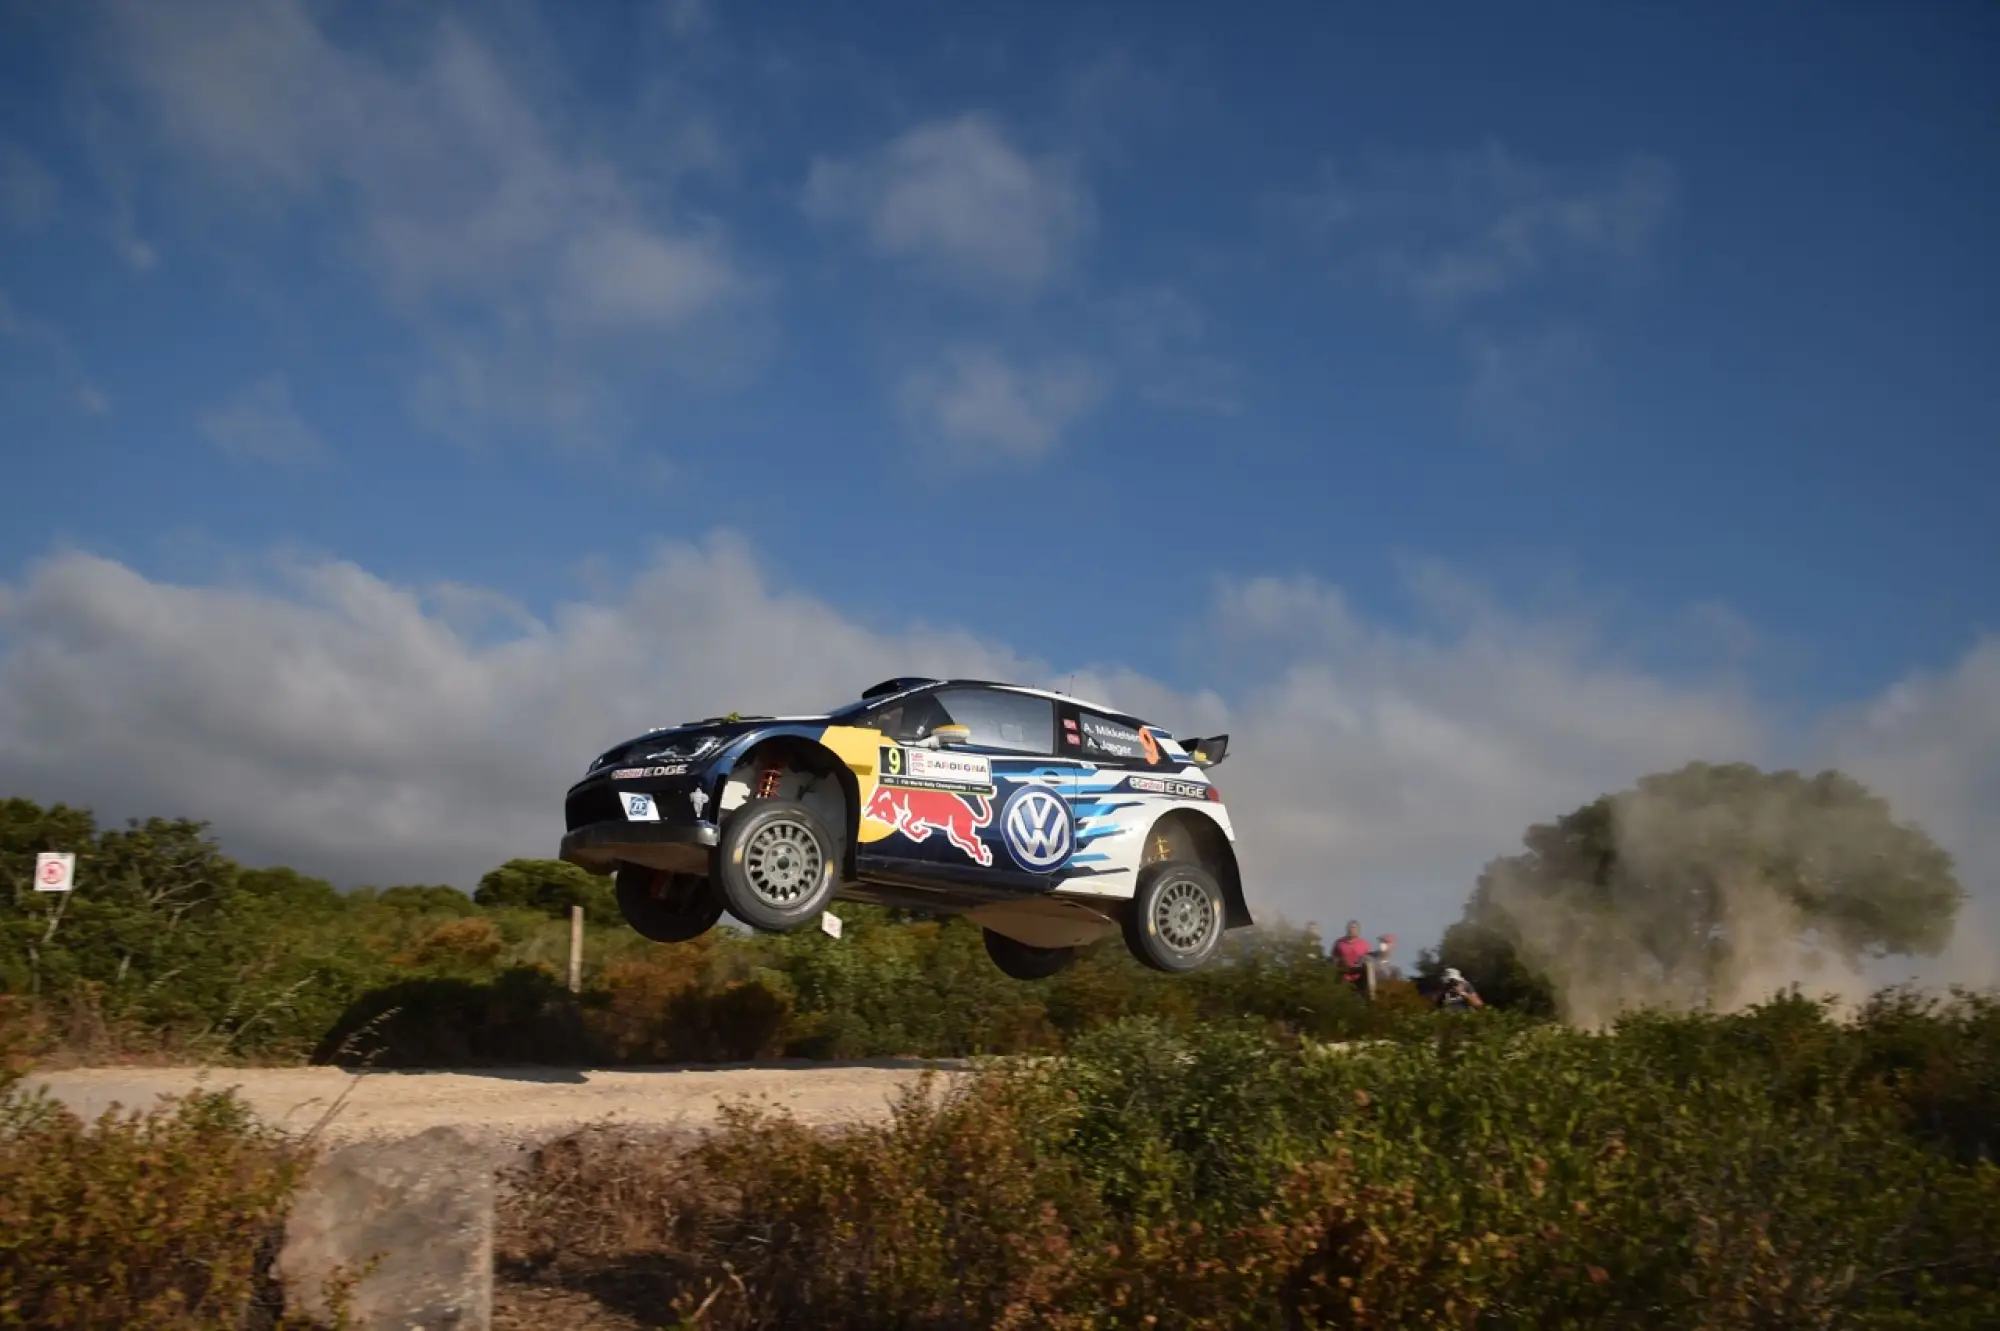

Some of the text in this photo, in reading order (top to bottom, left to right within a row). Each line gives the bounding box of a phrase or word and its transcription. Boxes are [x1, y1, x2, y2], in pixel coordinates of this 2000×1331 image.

[1139, 728, 1158, 765] 9
[644, 763, 688, 777] EDGE
[889, 747, 900, 775] 9
[1166, 782, 1205, 799] EDGE
